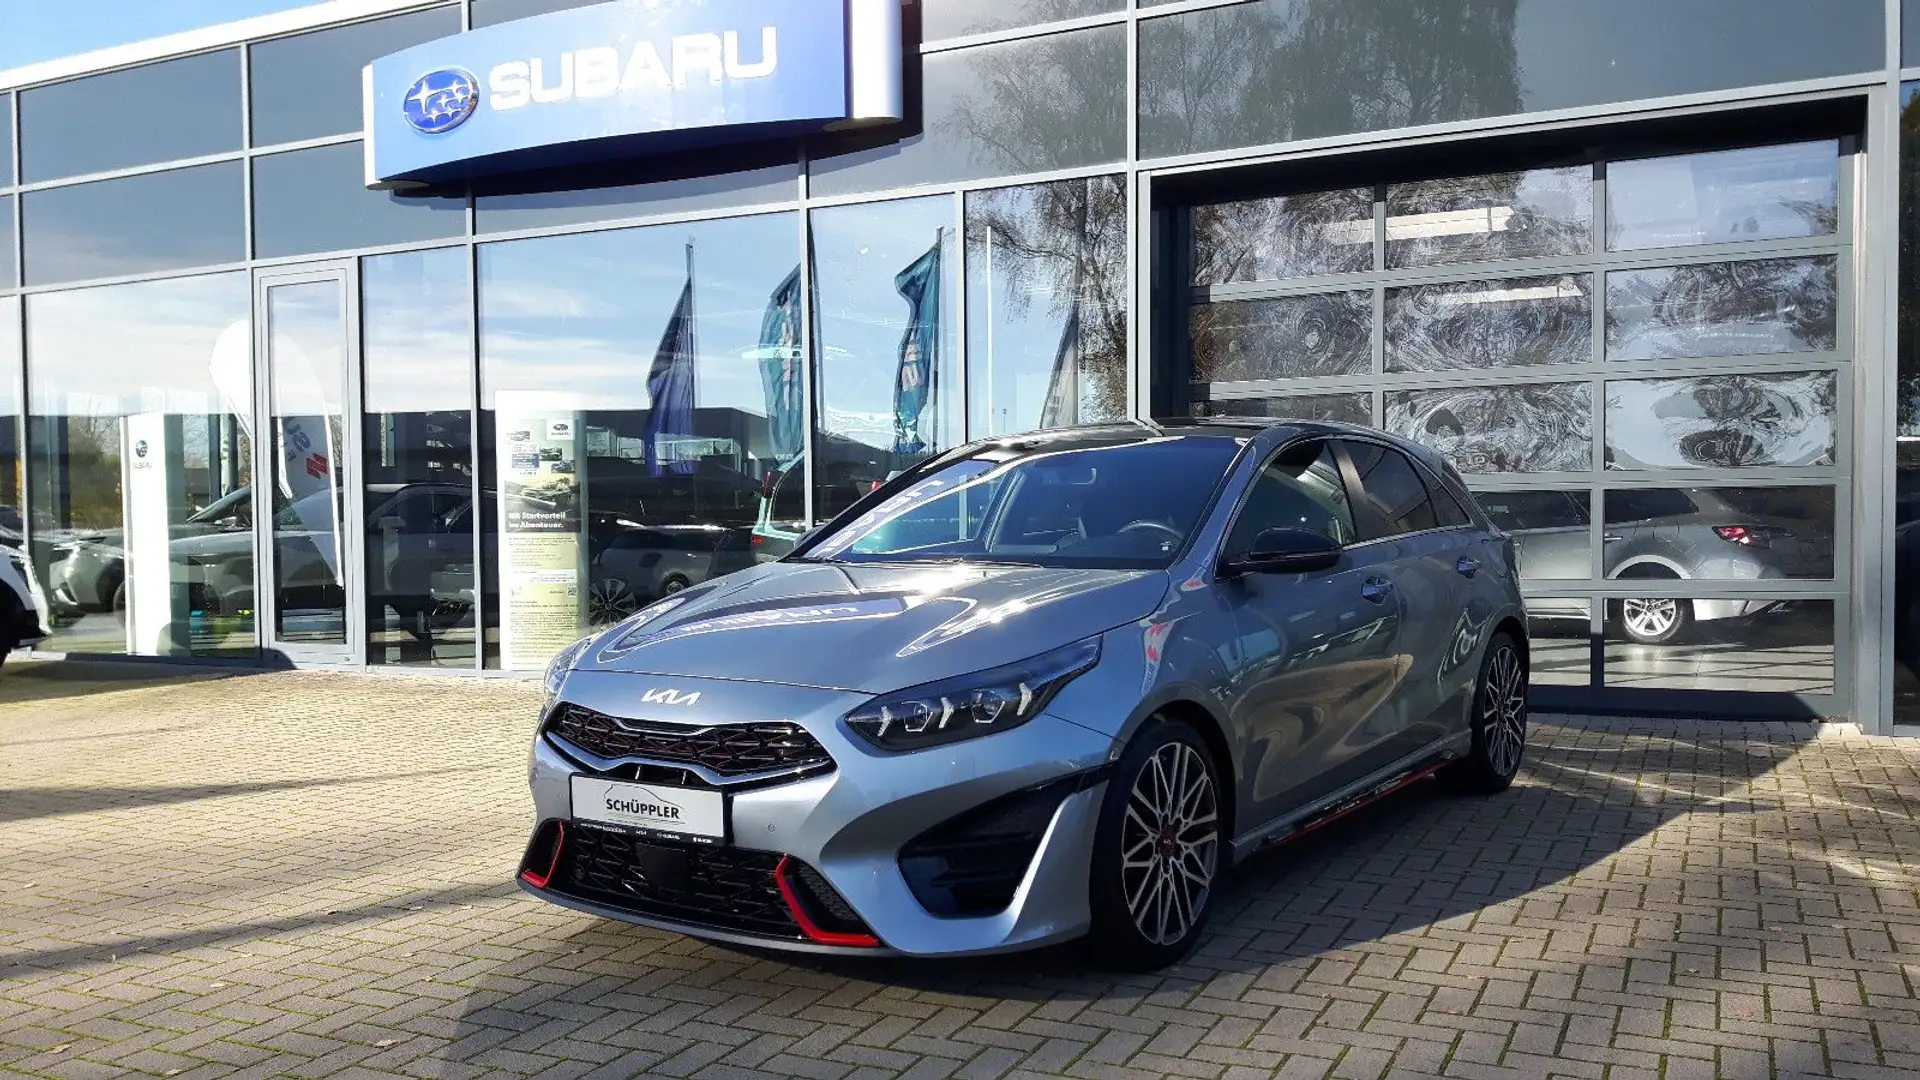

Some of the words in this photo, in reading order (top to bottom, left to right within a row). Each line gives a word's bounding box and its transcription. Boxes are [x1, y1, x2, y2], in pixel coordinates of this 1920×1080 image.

[489, 26, 778, 111] SUBARU
[641, 688, 701, 706] KIA
[606, 798, 680, 819] SCHÜPPLER
